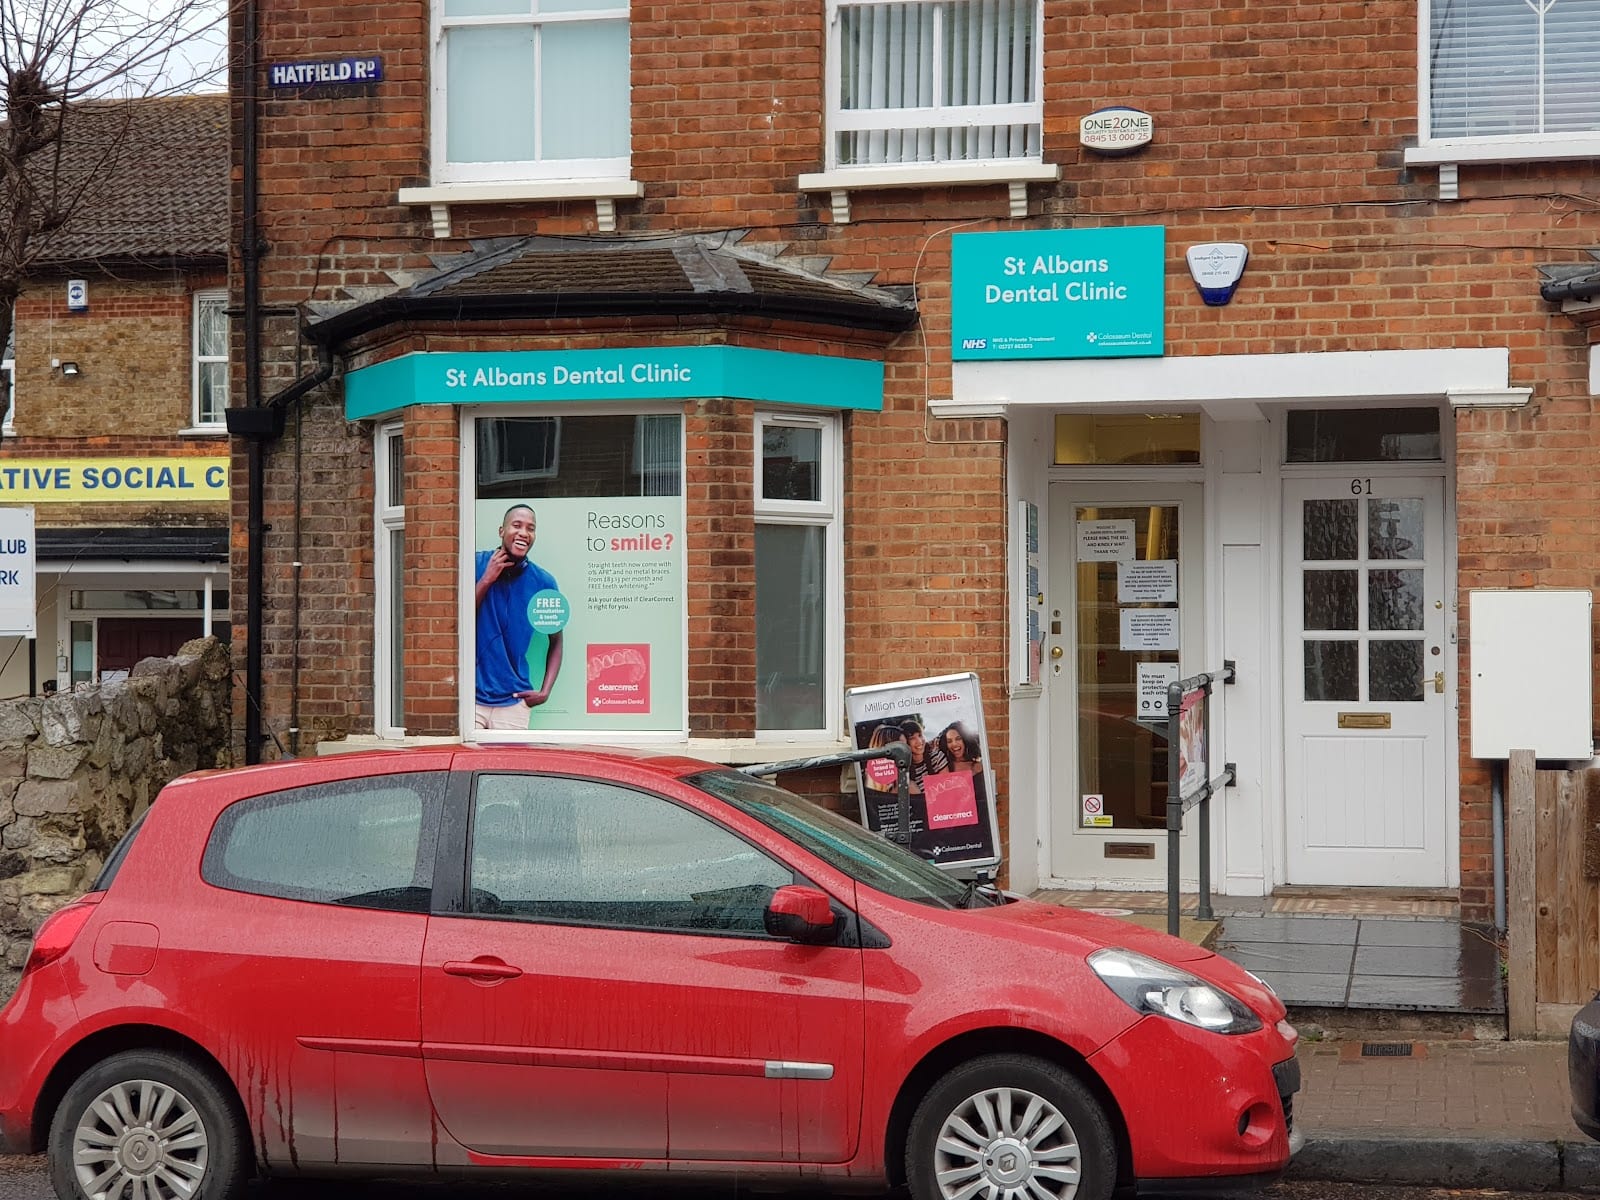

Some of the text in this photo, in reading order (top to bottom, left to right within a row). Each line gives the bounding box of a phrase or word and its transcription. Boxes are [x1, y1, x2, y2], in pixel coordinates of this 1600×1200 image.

[274, 62, 352, 84] HATFIELD
[1084, 117, 1149, 130] ONE2ONE
[1084, 132, 1149, 143] 0845 13 000 25
[1003, 254, 1109, 276] St Albans
[985, 281, 1128, 304] Dental Clinic
[1131, 331, 1153, 339] Dental
[962, 339, 987, 349] NHS
[445, 362, 692, 387] St Albans Dental Clinic
[0, 466, 229, 490] TIVE SOCIAL C
[1351, 478, 1372, 495] 61
[587, 511, 666, 529] Reasons
[586, 533, 674, 552] to smile?
[588, 561, 611, 569] Straight
[536, 597, 561, 608] FREE
[598, 683, 639, 691] clearcorrect
[864, 692, 961, 713] Million dollar smiles.
[933, 811, 973, 822] clearcorrect
[941, 841, 983, 853] Colosseum Dental
